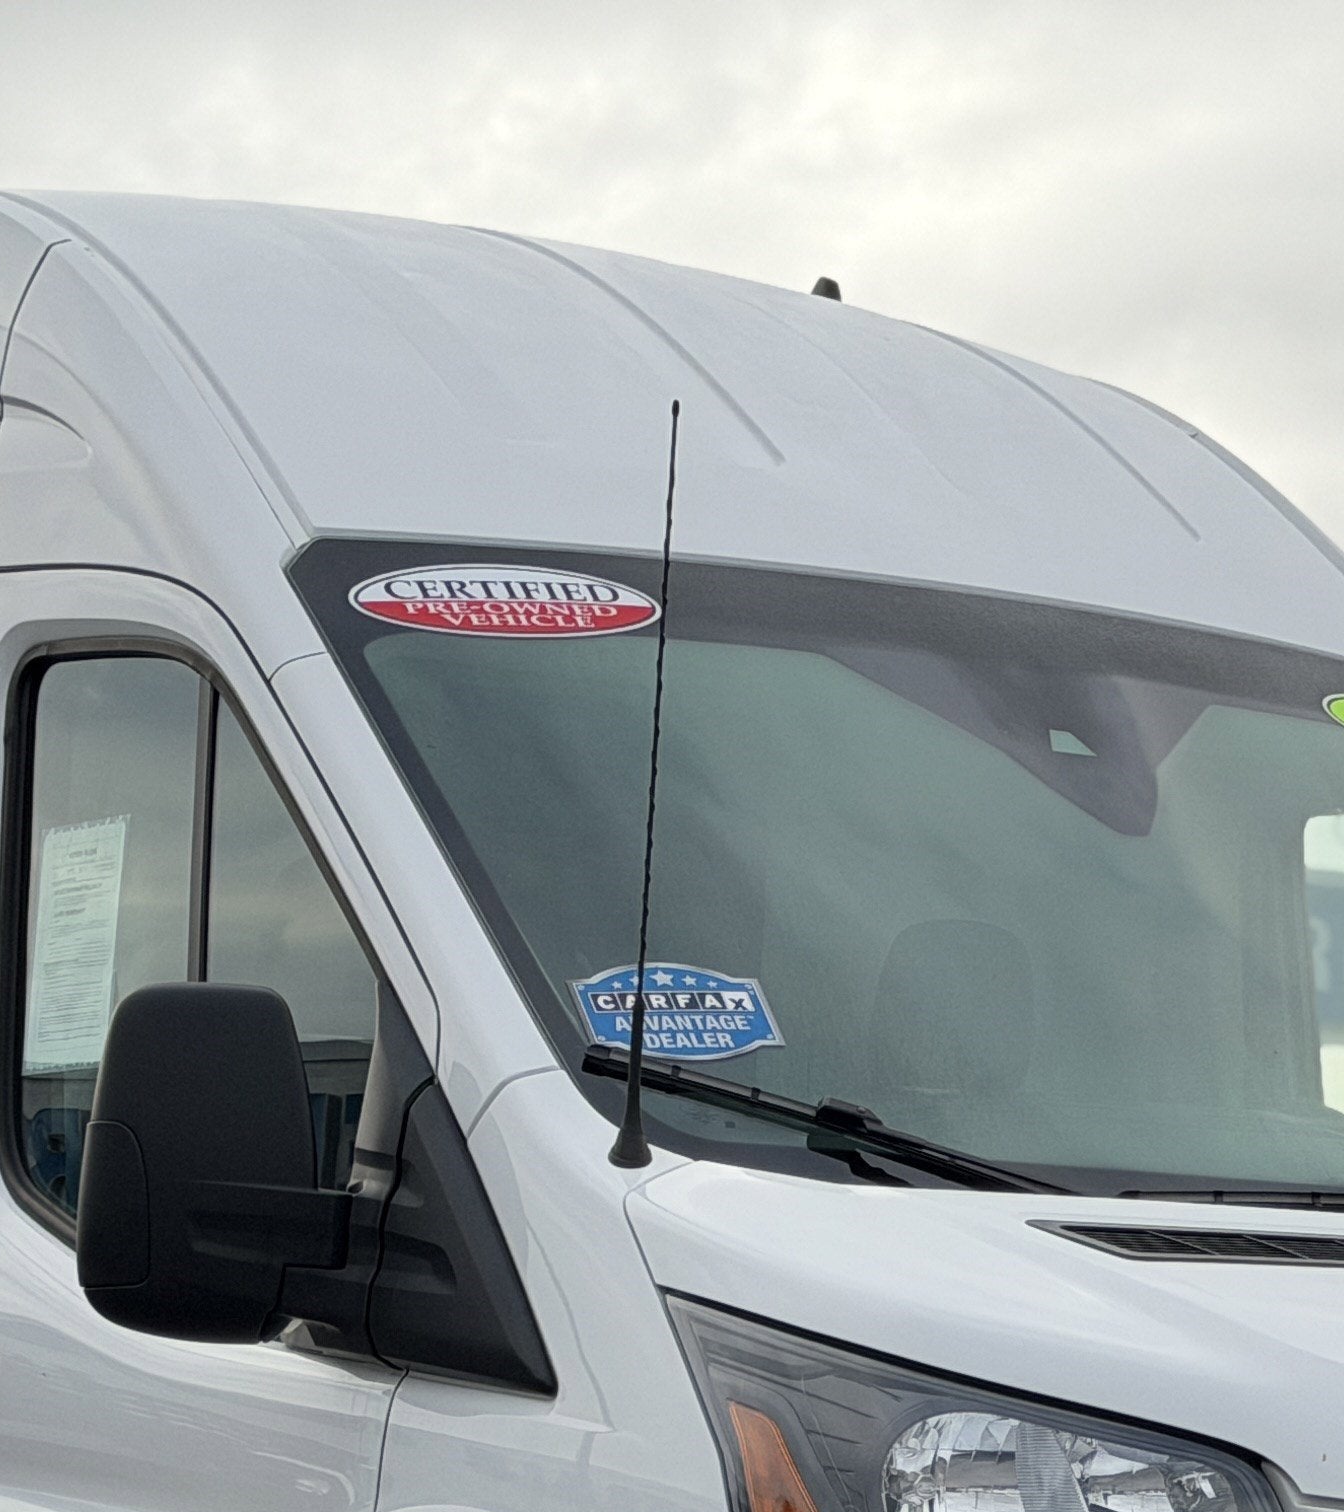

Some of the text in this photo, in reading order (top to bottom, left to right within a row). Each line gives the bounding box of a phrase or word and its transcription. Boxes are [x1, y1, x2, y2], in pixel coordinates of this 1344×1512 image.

[384, 580, 620, 603] CERTIFIED
[404, 601, 618, 617] PRE-OWNED
[440, 613, 596, 628] VEHICLE
[642, 1033, 735, 1048] DEALER
